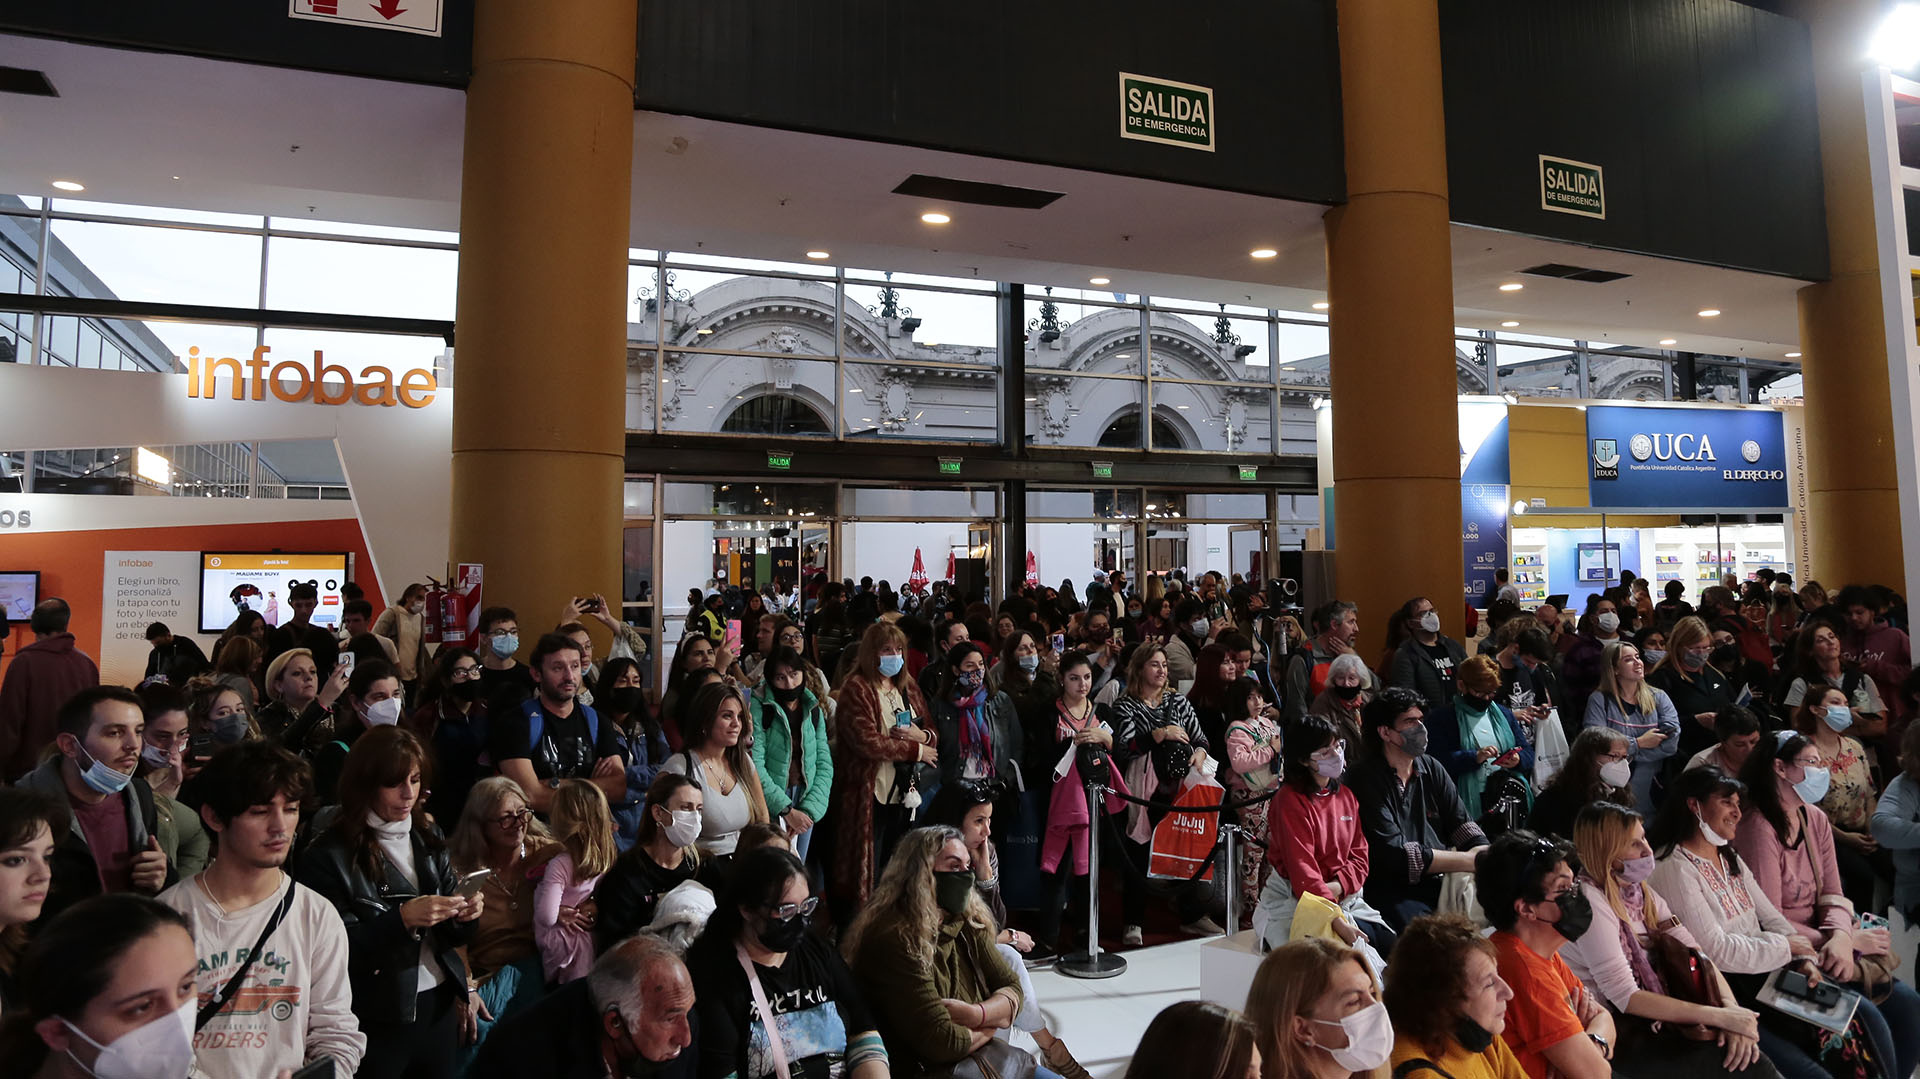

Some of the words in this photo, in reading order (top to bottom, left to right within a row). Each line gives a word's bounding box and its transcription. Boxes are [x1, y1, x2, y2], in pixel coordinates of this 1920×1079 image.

[1128, 87, 1206, 124] SALIDA
[1128, 116, 1142, 126] DE
[1144, 118, 1207, 137] EMERGENCIA
[1546, 167, 1599, 196] SALIDA
[1546, 191, 1556, 200] DE
[1557, 193, 1600, 208] EMERGENCIA
[187, 345, 438, 408] infobae
[1651, 433, 1717, 461] UCA
[1795, 427, 1805, 471] Argentina
[768, 457, 791, 467] SALIDA
[941, 463, 960, 472] SALIDA
[1094, 467, 1112, 476] SALIDA
[1723, 470, 1734, 480] EL
[1735, 470, 1784, 482] DERECHO
[1797, 473, 1807, 509] Católica
[1800, 509, 1810, 563] Universidad
[118, 559, 153, 567] infobae
[118, 576, 142, 587] Elegí
[157, 577, 180, 586] libro,
[1802, 564, 1810, 586] ificia
[117, 588, 172, 597] personalizá
[117, 599, 125, 607] la
[128, 600, 149, 608] tapa
[171, 599, 181, 607] tu
[117, 610, 136, 618] foto
[146, 609, 178, 617] llevate
[116, 632, 128, 640] de
[130, 632, 146, 641] reg
[193, 1031, 268, 1049] RIDERS
